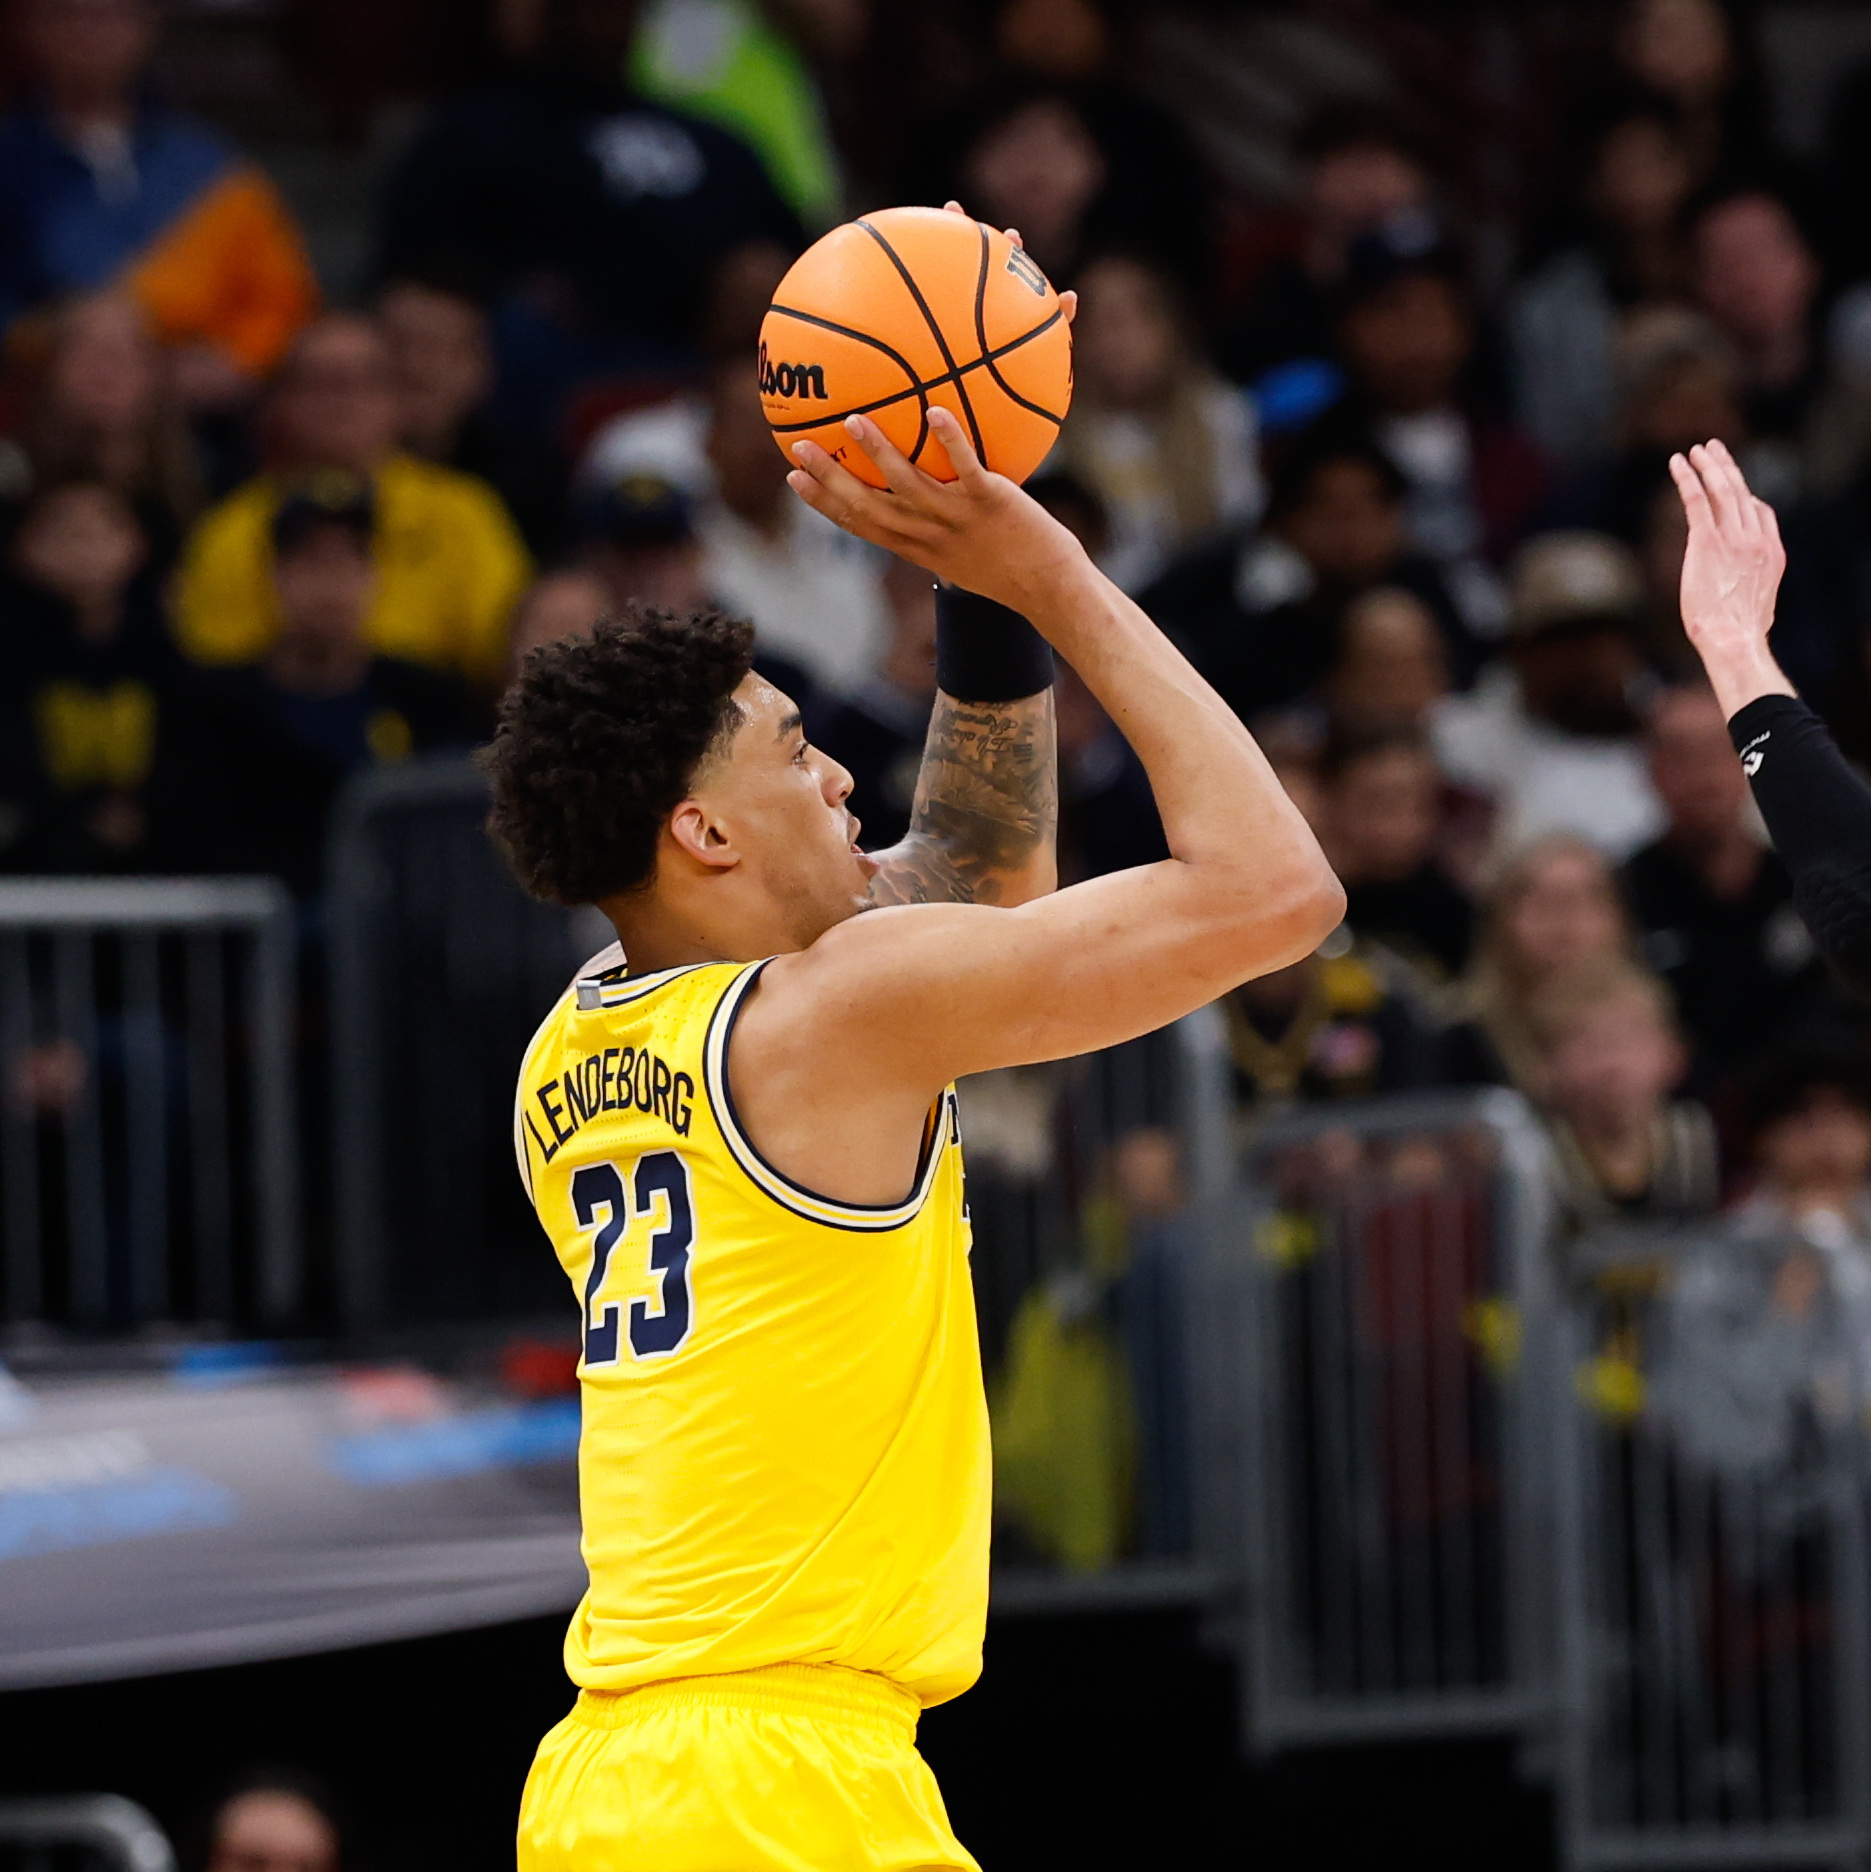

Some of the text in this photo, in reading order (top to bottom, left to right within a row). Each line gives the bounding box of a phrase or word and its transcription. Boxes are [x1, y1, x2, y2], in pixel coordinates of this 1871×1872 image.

[759, 340, 828, 399] lson
[526, 1047, 695, 1163] LENDEBORG
[569, 1147, 697, 1370] 23
